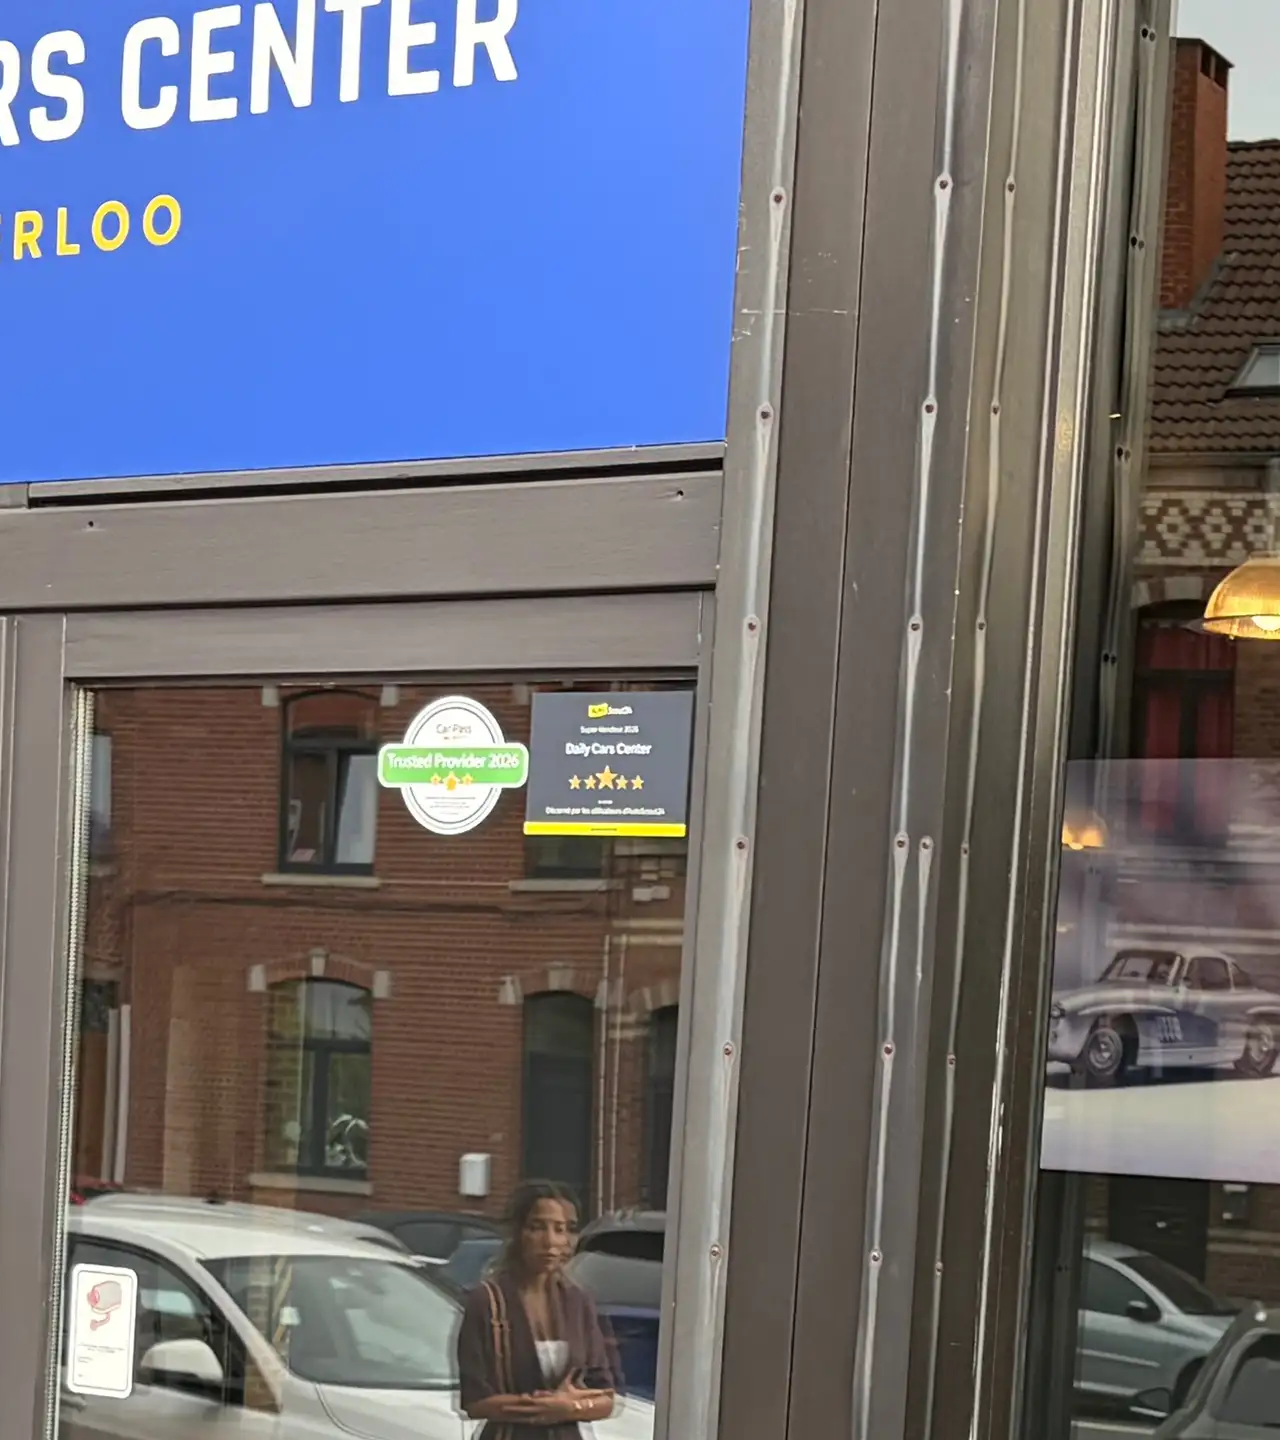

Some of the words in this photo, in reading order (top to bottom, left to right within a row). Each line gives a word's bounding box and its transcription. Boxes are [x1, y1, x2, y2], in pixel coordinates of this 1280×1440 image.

[120, 0, 519, 131] CENTER
[565, 742, 591, 758] Daily
[591, 742, 615, 755] Cars
[616, 742, 652, 756] Center
[387, 753, 433, 769] Trusted
[434, 753, 486, 769] Provider
